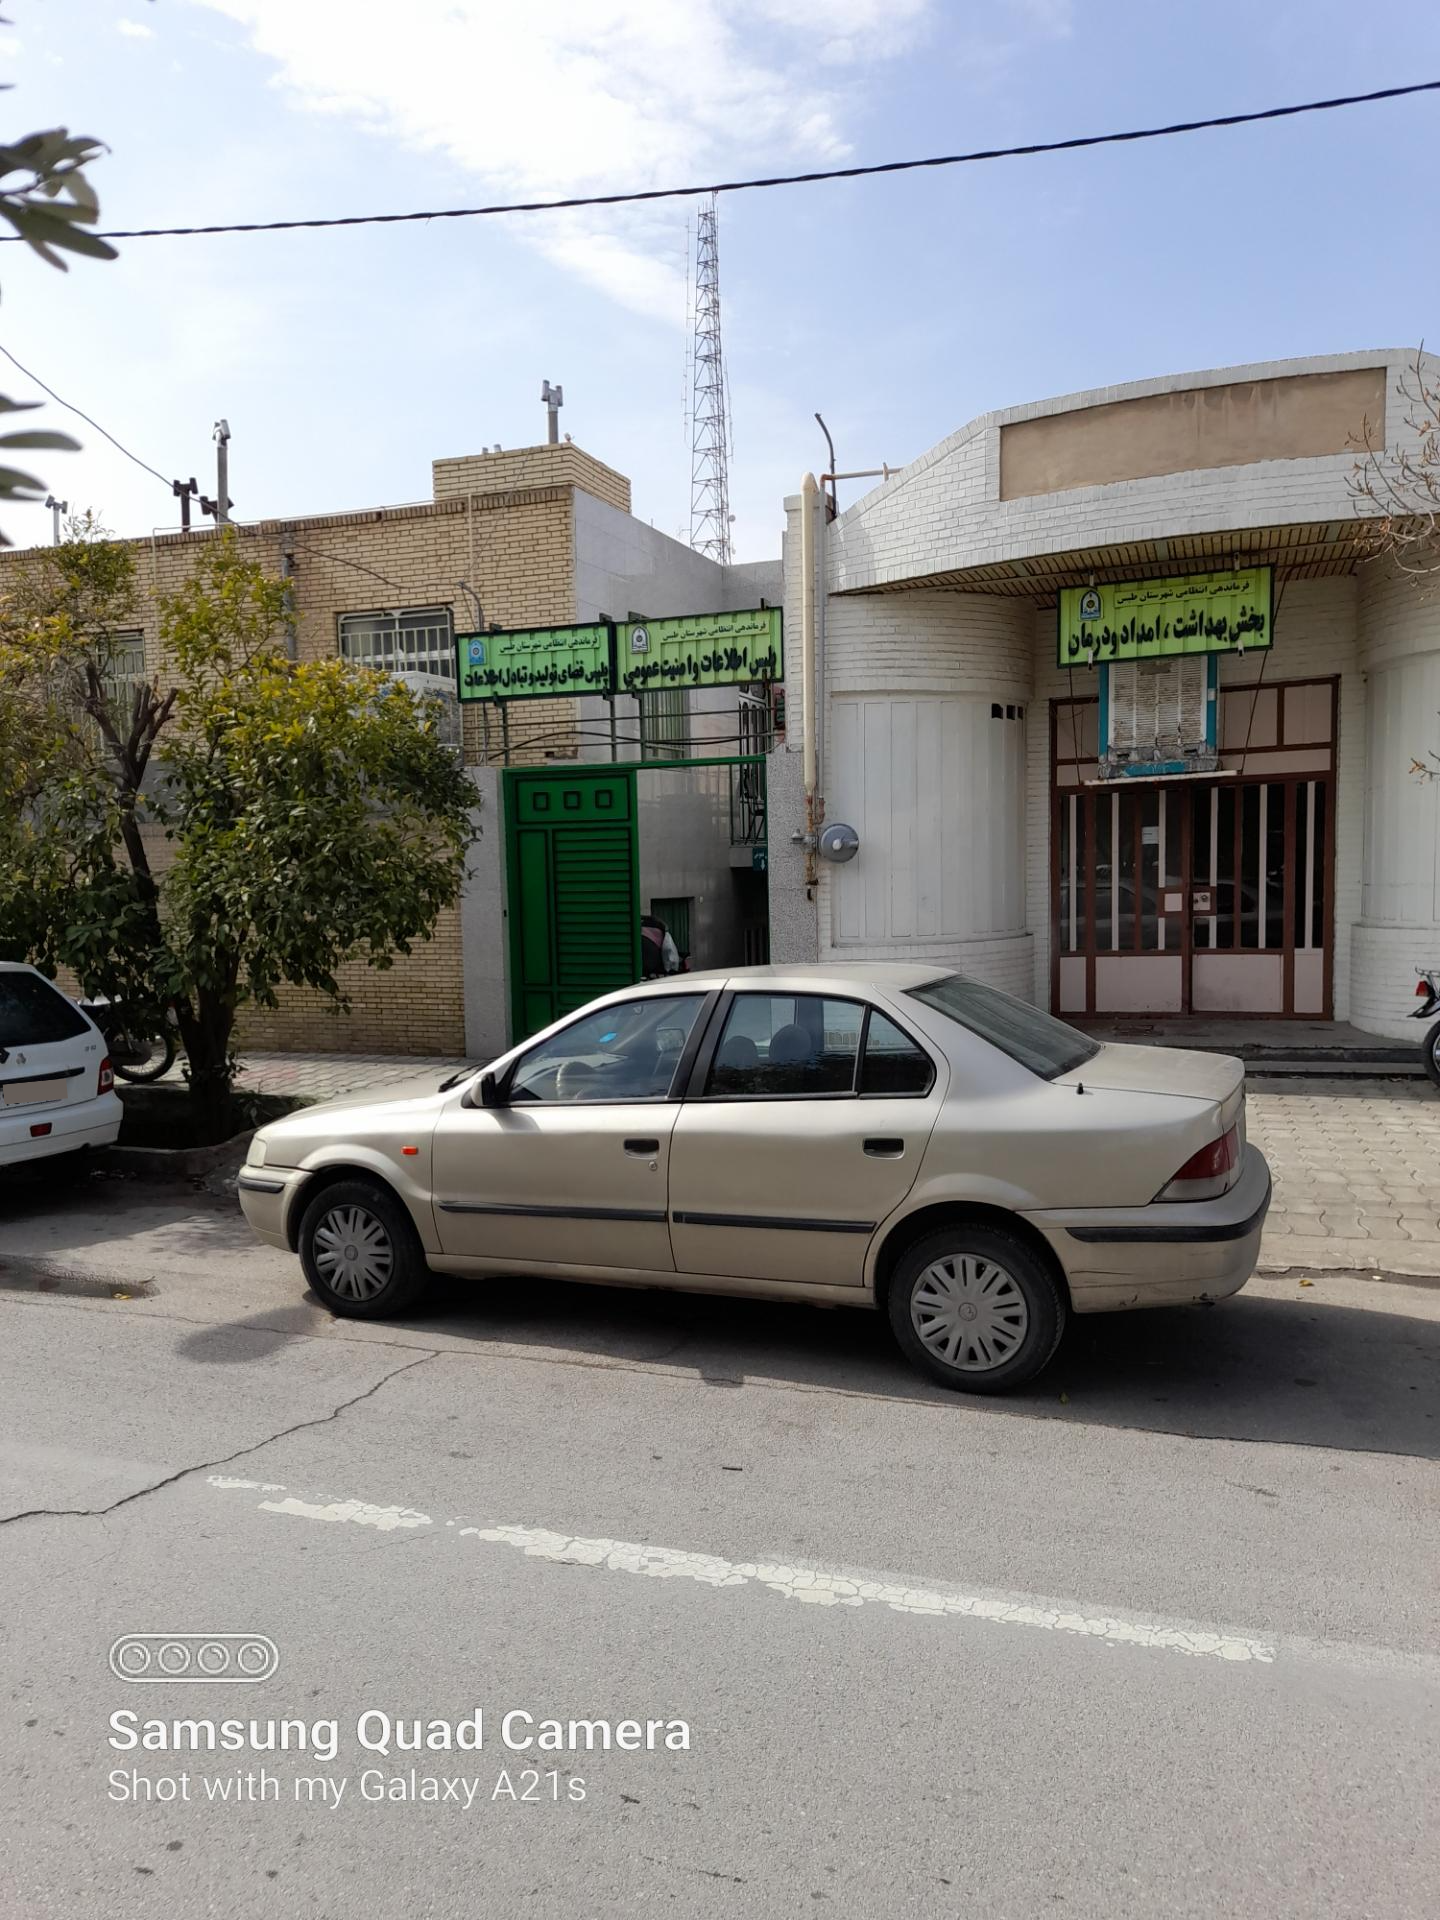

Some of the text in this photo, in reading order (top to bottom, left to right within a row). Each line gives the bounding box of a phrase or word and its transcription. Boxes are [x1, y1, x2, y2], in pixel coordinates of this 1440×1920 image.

[1117, 581, 1250, 604] فرماندهی انتظامی شهرستان طبس
[680, 628, 707, 638] شهرستان
[708, 624, 733, 636] انتظامی
[734, 621, 766, 633] فرماندهی
[1120, 614, 1161, 644] امداد
[1229, 605, 1265, 642] بخش
[516, 640, 541, 652] شهرستان
[543, 638, 567, 650] انتظامی
[568, 635, 598, 648] فرماندهی
[701, 646, 747, 673] اطلاعات
[749, 644, 776, 680] پلیس
[464, 668, 502, 687] اطلاعات
[558, 659, 585, 685] فضای
[585, 661, 609, 686] پلیس
